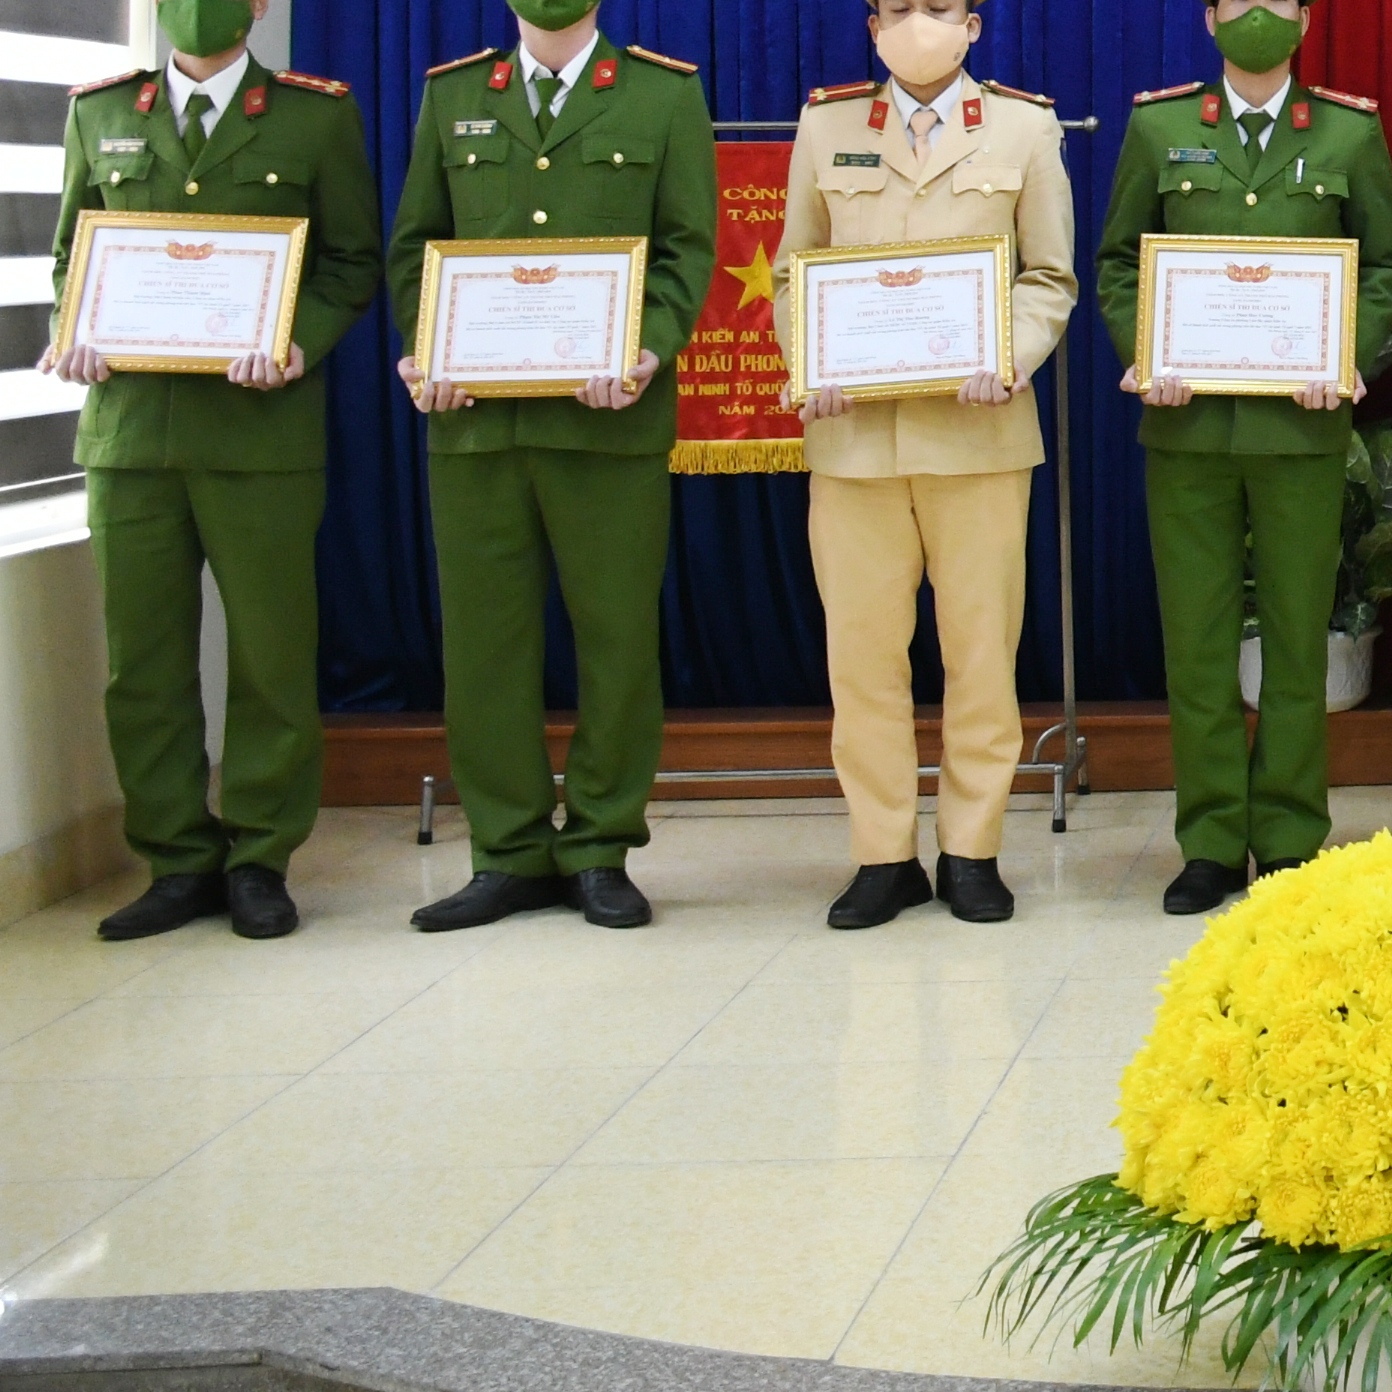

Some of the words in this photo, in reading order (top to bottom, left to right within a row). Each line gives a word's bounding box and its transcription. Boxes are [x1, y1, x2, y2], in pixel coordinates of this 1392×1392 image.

[702, 328, 734, 343] KIẾN
[739, 354, 787, 372] PHON
[698, 383, 730, 396] NINH
[718, 401, 756, 416] NĂM
